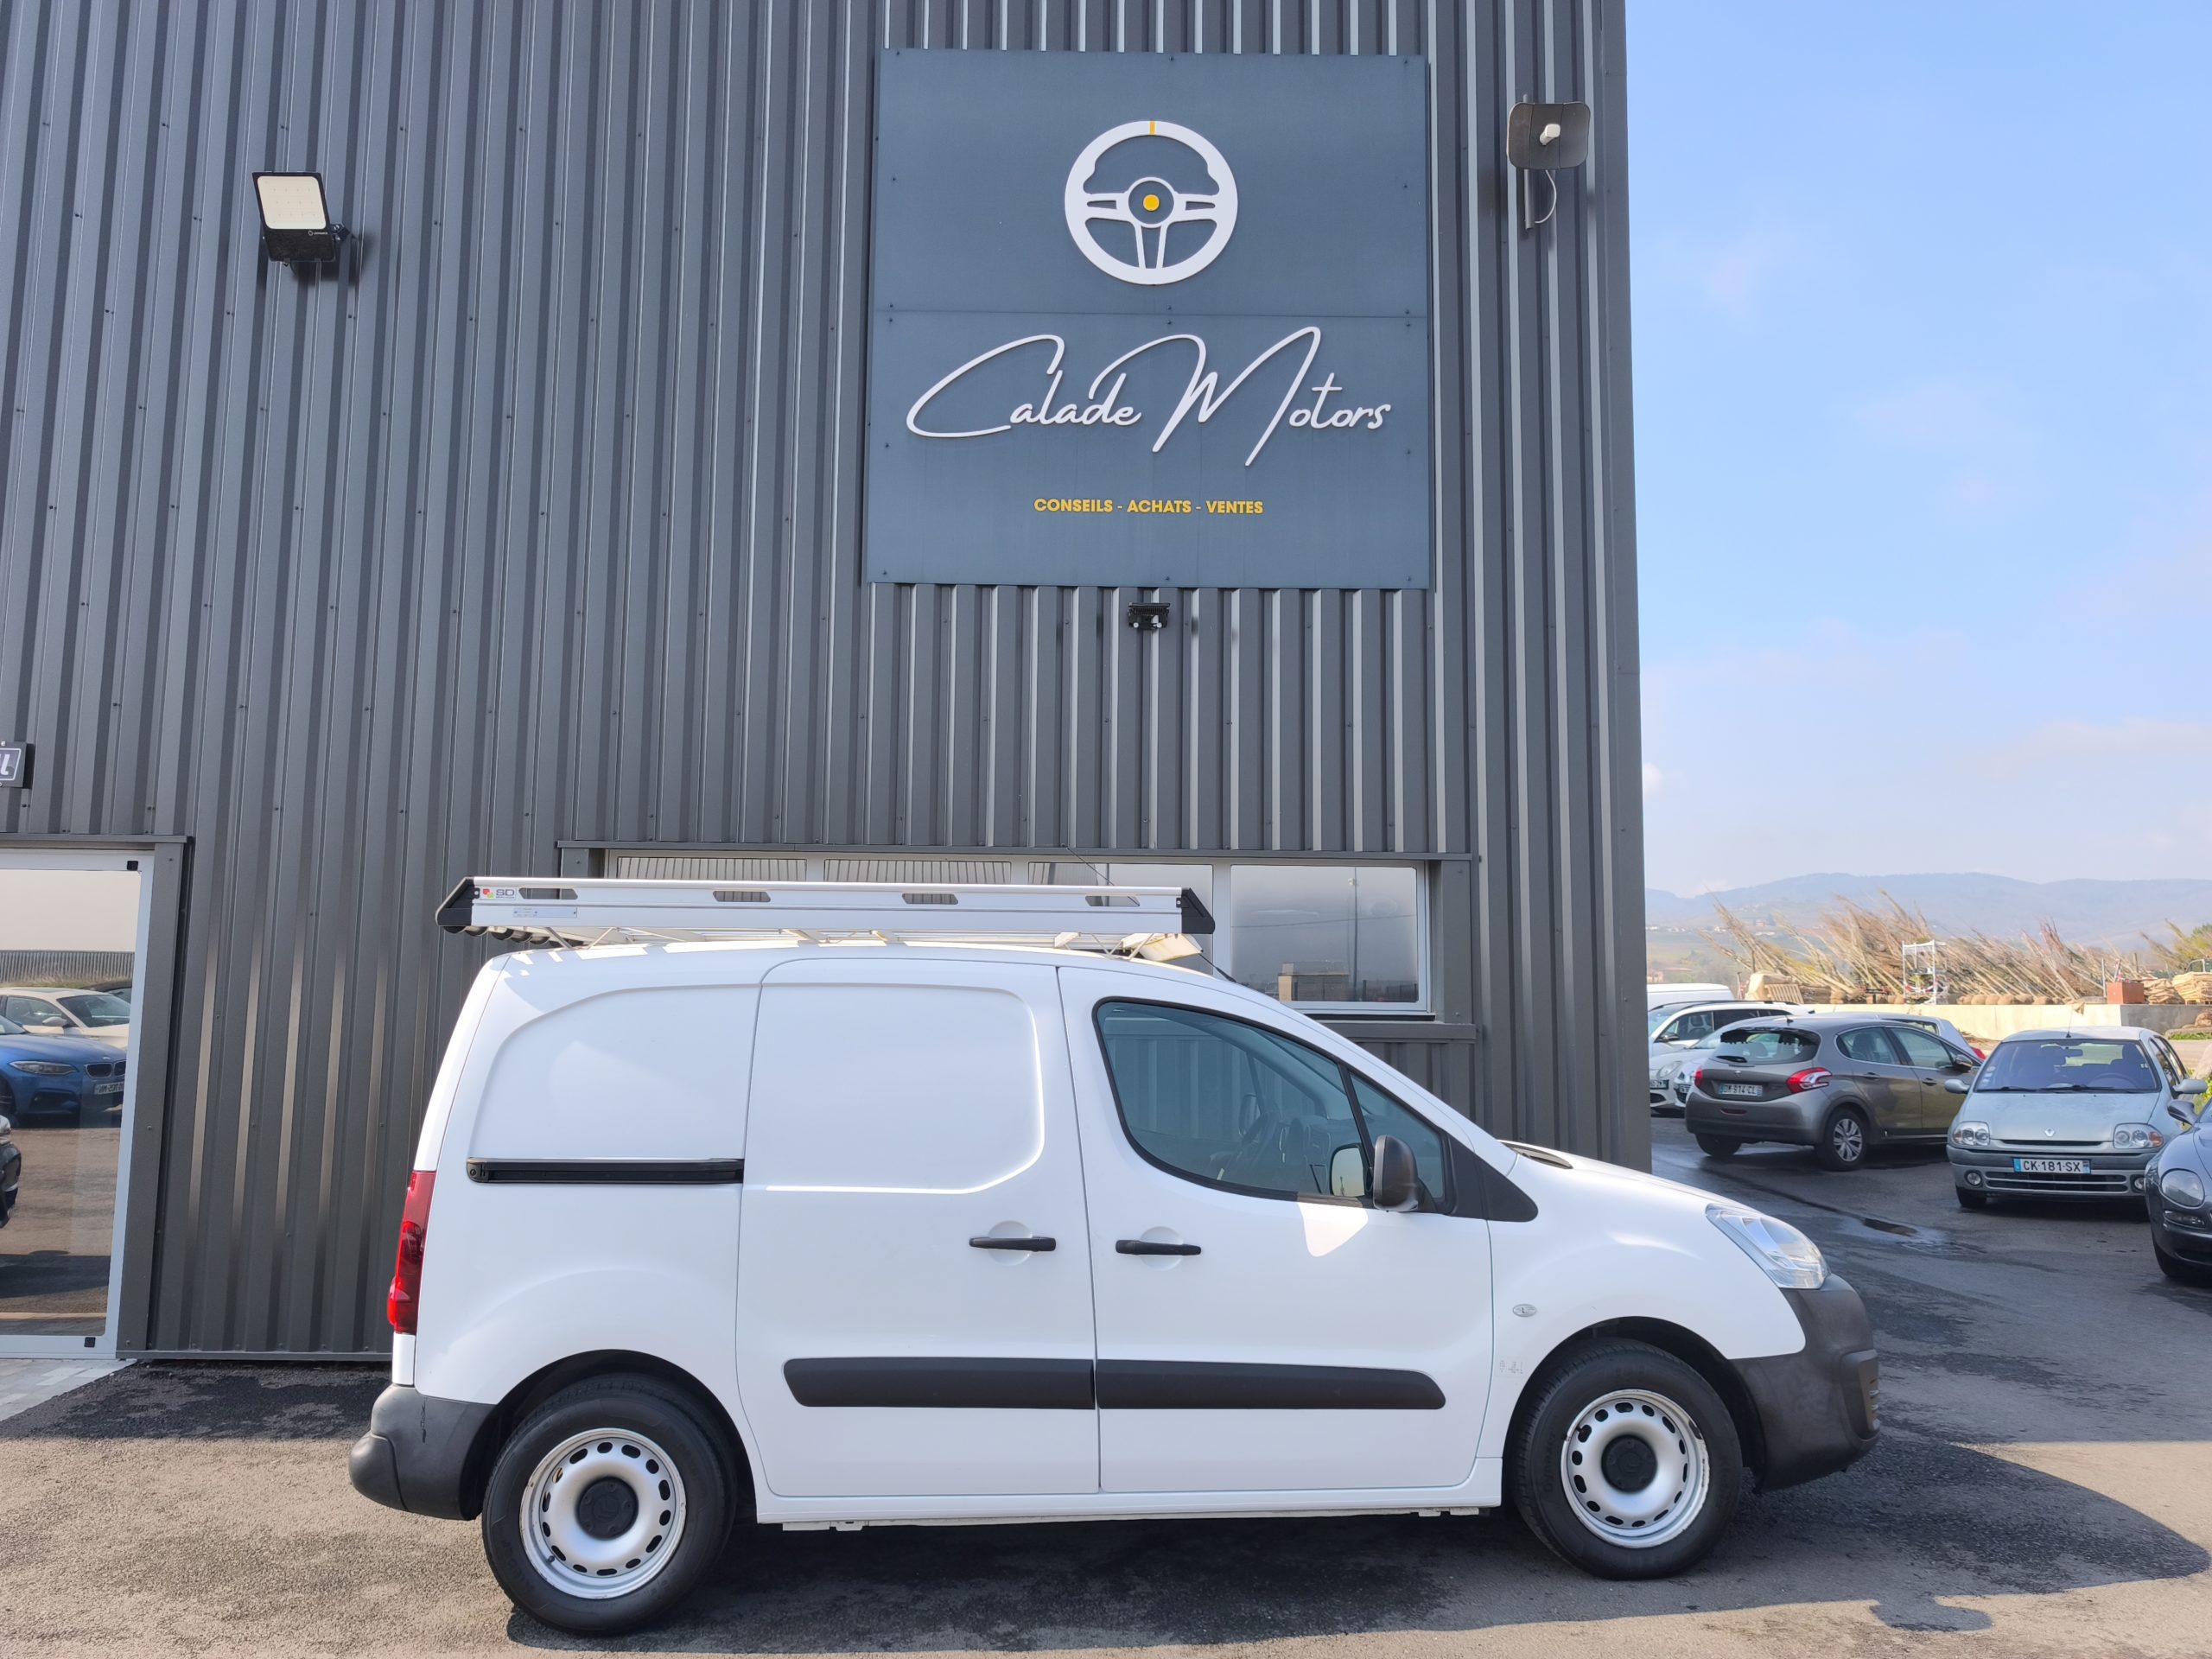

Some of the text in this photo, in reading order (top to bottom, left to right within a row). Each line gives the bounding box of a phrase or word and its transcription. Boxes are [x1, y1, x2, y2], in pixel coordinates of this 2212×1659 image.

[906, 326, 1392, 467] Calade Motors
[1033, 498, 1114, 512] CONSEILS
[1126, 499, 1192, 513] ACHATS
[1205, 500, 1264, 514] VENTES
